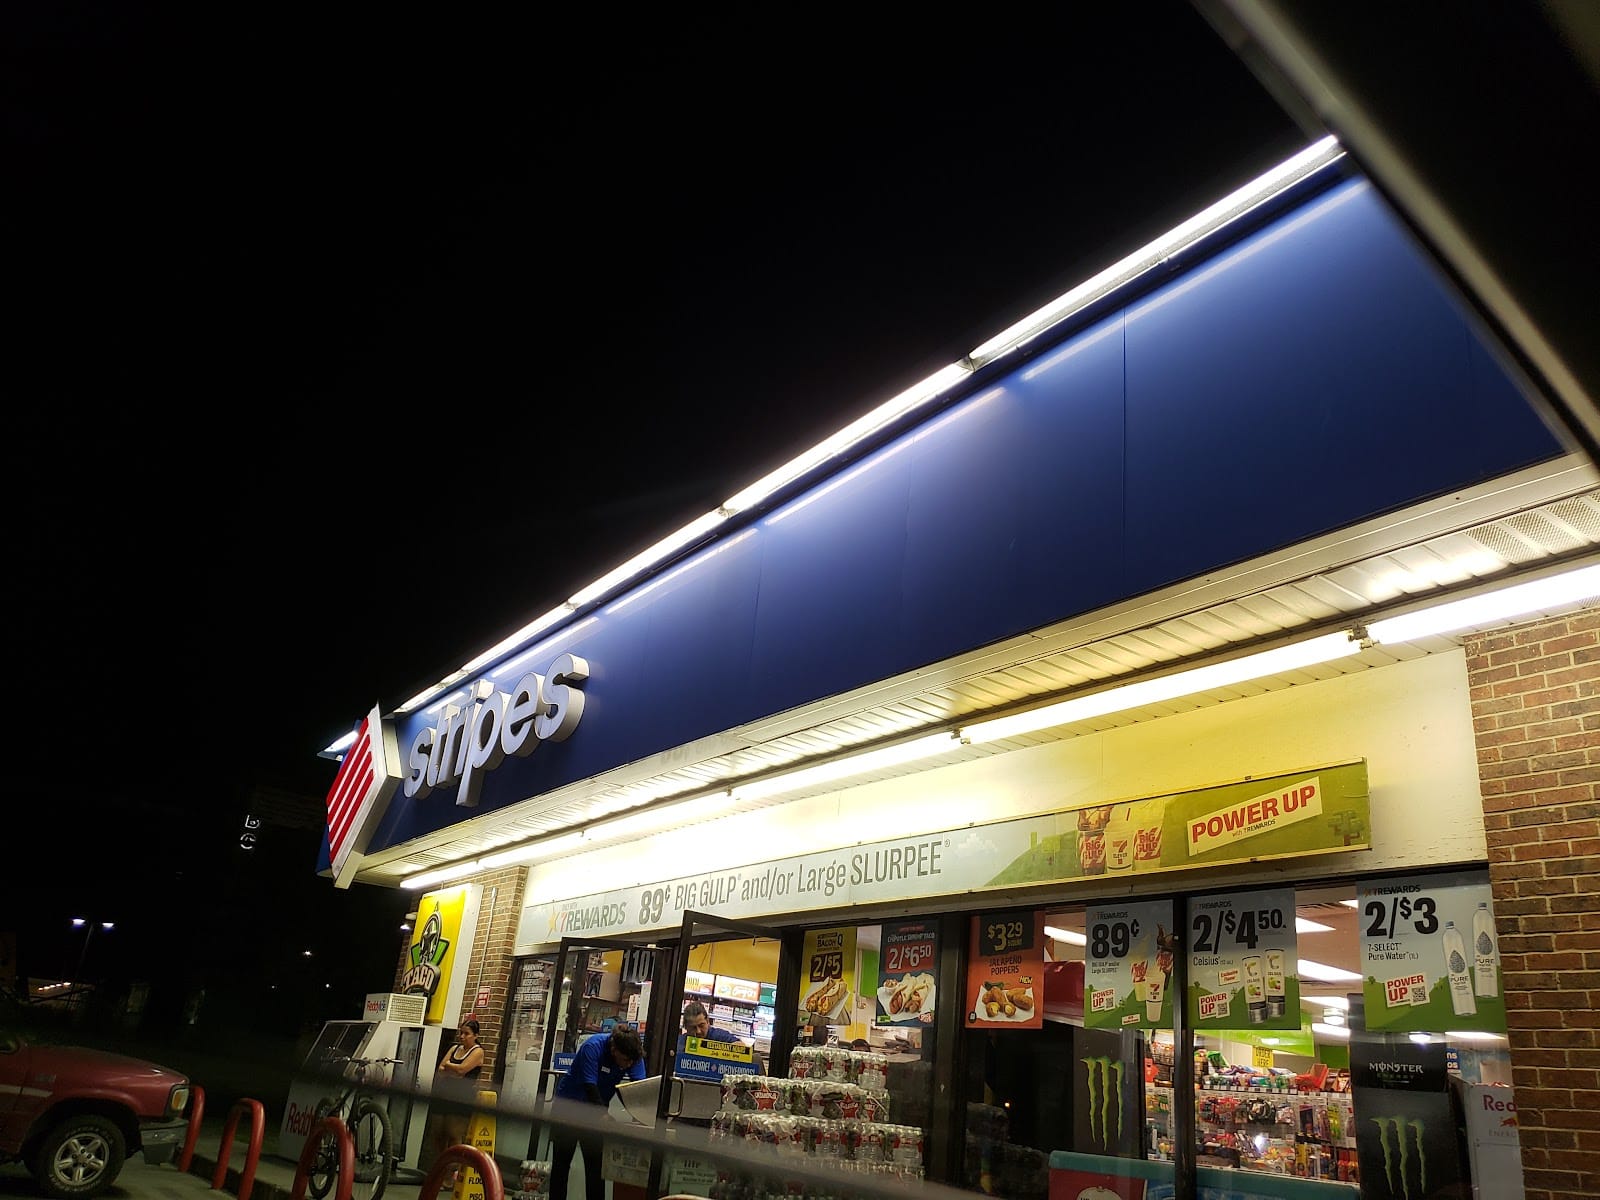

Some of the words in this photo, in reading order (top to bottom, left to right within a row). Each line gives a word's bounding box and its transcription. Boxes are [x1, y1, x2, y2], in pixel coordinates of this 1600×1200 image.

[404, 653, 589, 807] stripes
[1192, 798, 1279, 843] POWER
[1282, 785, 1315, 813] UP
[1140, 832, 1155, 843] BIG
[1086, 840, 1101, 850] BIG
[675, 884, 697, 911] BIG
[741, 867, 794, 900] and/or
[797, 859, 846, 897] Large
[1365, 896, 1438, 939] 2/$3
[1092, 919, 1139, 958] 89¢
[1193, 957, 1219, 966] Celsius
[1368, 952, 1384, 960] Pure
[1385, 952, 1406, 960] Water
[813, 954, 841, 977] 2/$5
[991, 965, 1019, 975] POPPERS
[404, 966, 435, 991] TACO
[1387, 975, 1424, 989] POWER
[1093, 989, 1114, 998] POWER
[1200, 993, 1227, 1004] POWER
[1389, 987, 1408, 1001] UP
[1093, 998, 1104, 1008] UP
[1201, 1003, 1214, 1014] UP
[681, 1058, 711, 1073] WELCOME!
[1369, 1061, 1424, 1074] MONSTER
